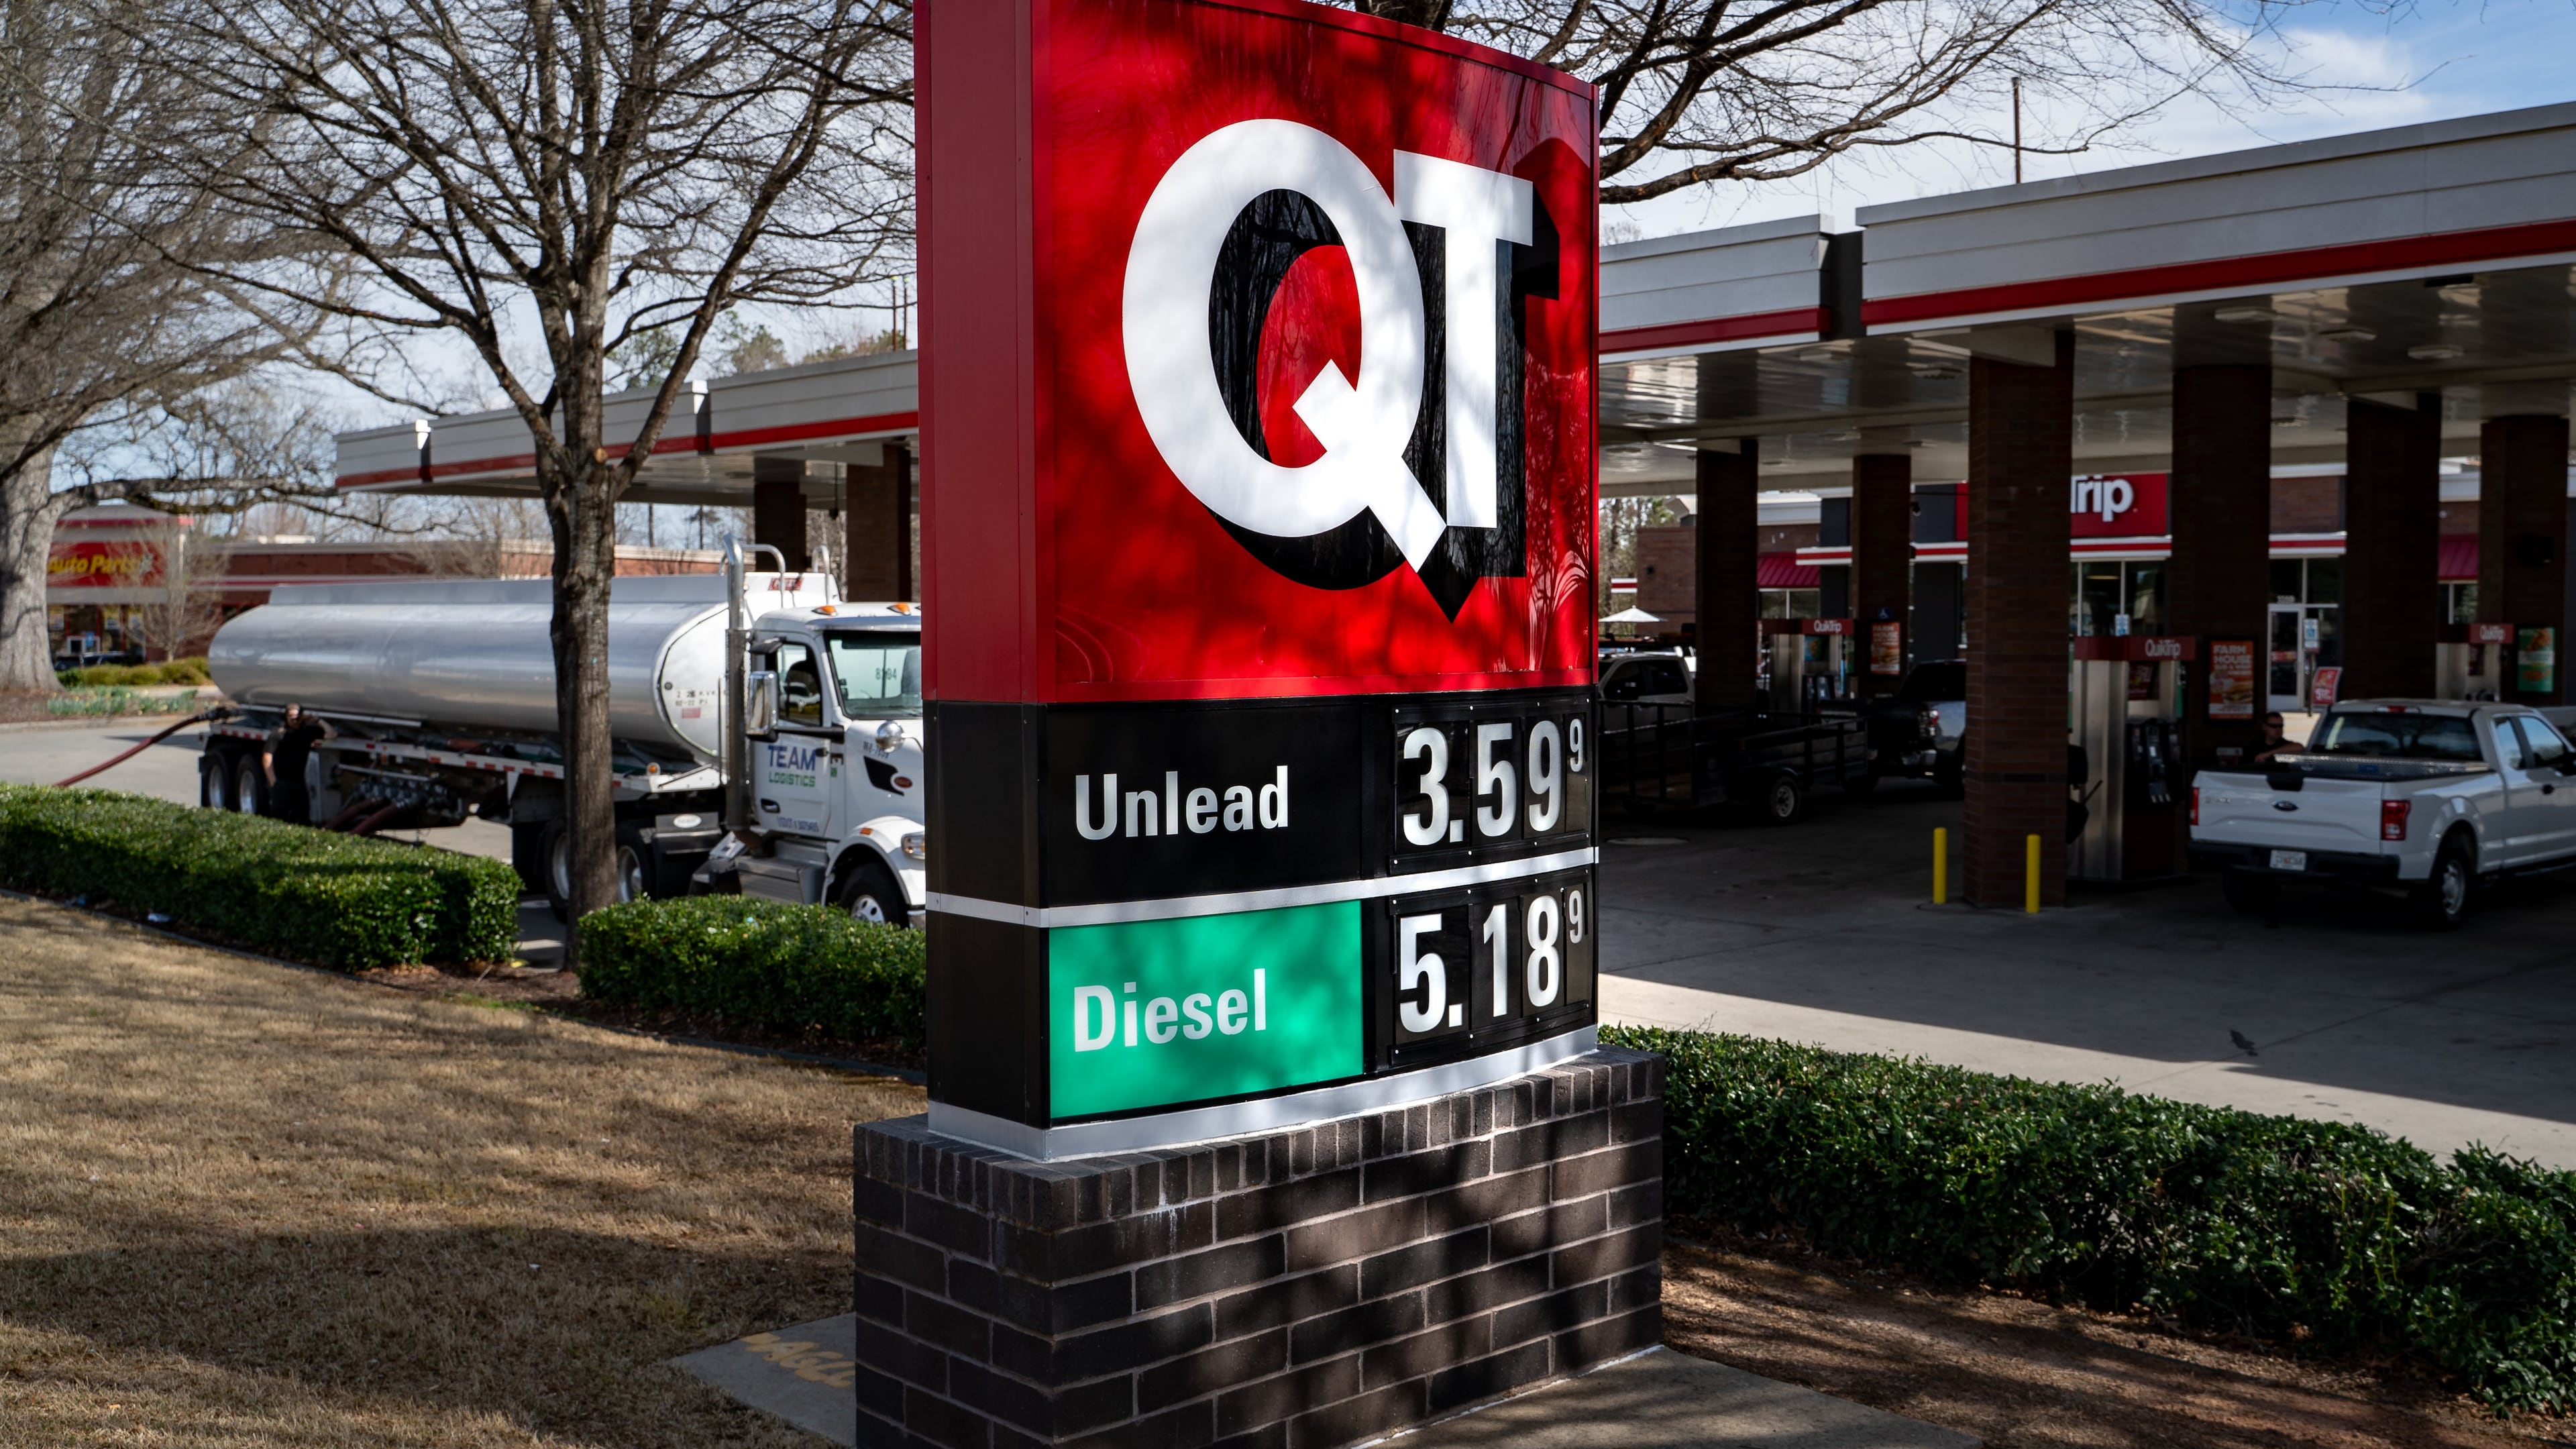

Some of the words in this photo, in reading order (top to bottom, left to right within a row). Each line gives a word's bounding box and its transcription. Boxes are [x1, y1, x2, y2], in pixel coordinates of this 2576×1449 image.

[1122, 118, 1534, 573] QT
[1813, 619, 1843, 633] QuikTrip
[2145, 639, 2182, 658] QuikTrip
[2212, 645, 2247, 654] FARM
[2212, 655, 2252, 664] HOUSE
[767, 745, 816, 771] TEAM
[769, 771, 816, 788] LOGISTICS
[1075, 765, 1289, 841] Unlead
[1074, 967, 1267, 1053] Diesel
